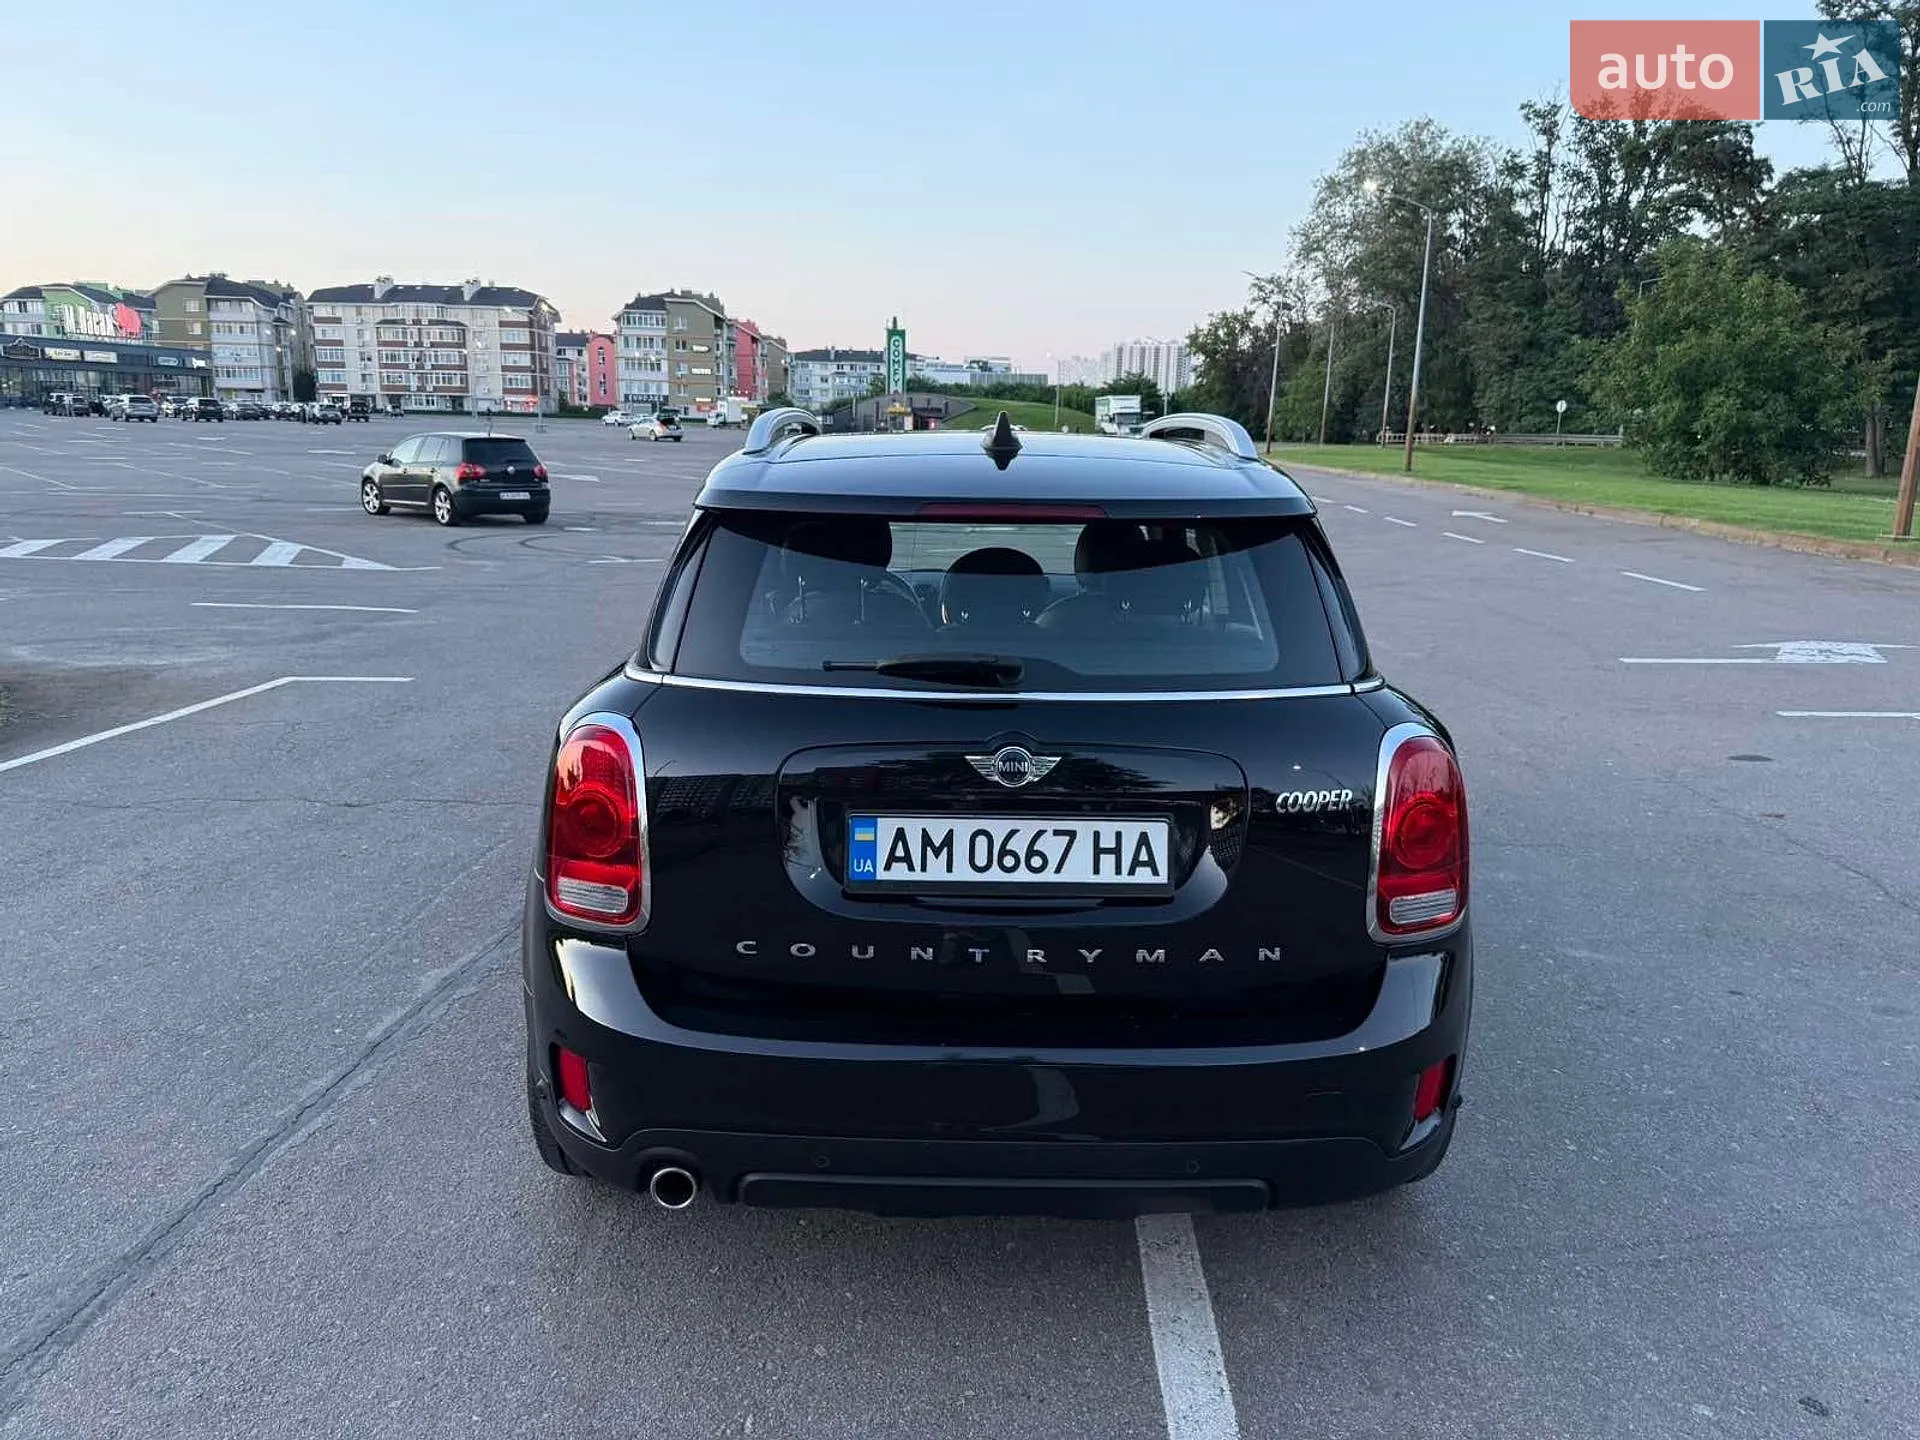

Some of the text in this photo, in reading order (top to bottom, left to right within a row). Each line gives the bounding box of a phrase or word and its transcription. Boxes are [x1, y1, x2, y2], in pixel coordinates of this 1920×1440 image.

[892, 338, 901, 387] COMFY
[998, 761, 1029, 773] MINI
[1275, 788, 1353, 814] COOPER
[883, 827, 1160, 877] AM 0667 HA
[853, 859, 874, 873] UA
[736, 940, 1281, 963] COUNTRYMAN
